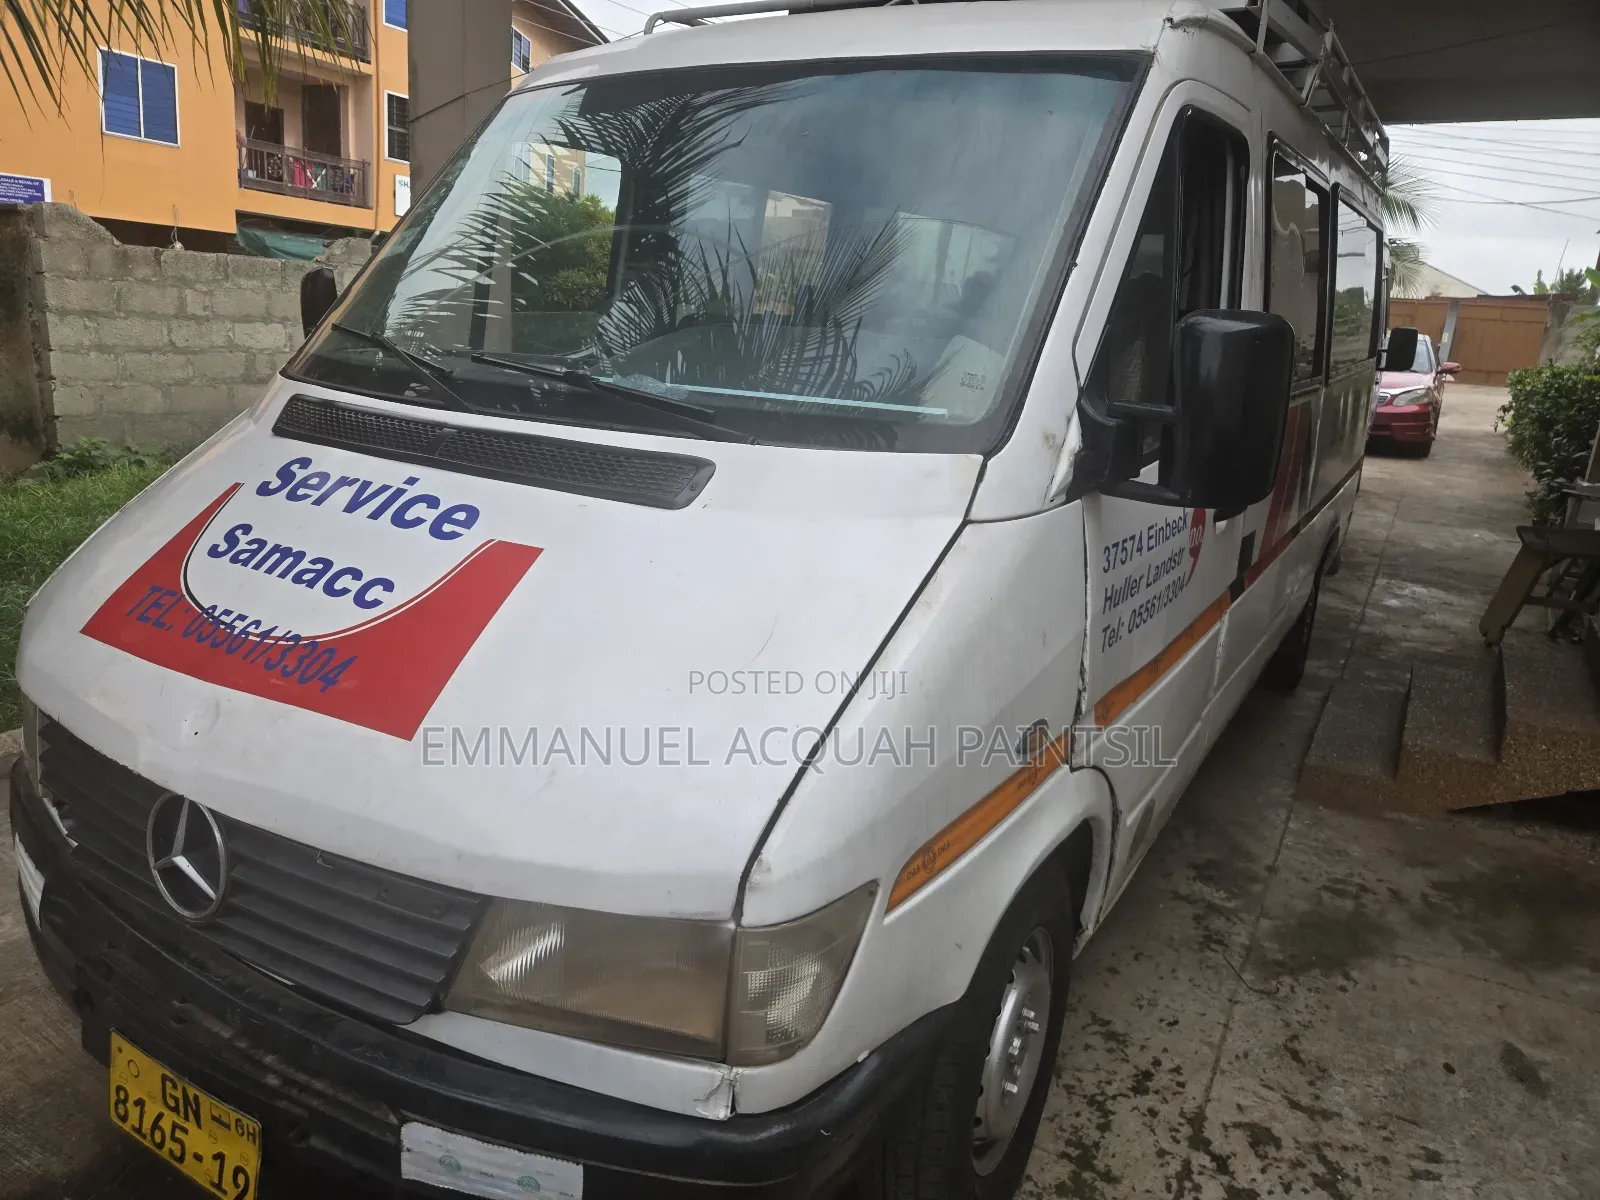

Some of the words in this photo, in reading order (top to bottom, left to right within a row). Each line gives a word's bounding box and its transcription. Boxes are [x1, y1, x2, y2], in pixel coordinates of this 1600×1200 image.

[255, 456, 480, 541] Service
[207, 523, 395, 610] Samacc
[1102, 530, 1143, 573] 37574
[1146, 508, 1188, 552] Einbeck
[1102, 572, 1144, 614] Huller
[1146, 546, 1185, 589] Landstr
[1102, 616, 1125, 653] Tel:
[1127, 571, 1186, 634] 05561/3304
[182, 604, 358, 694] 05561/3304
[161, 1073, 203, 1130] GN
[235, 1117, 256, 1146] GH
